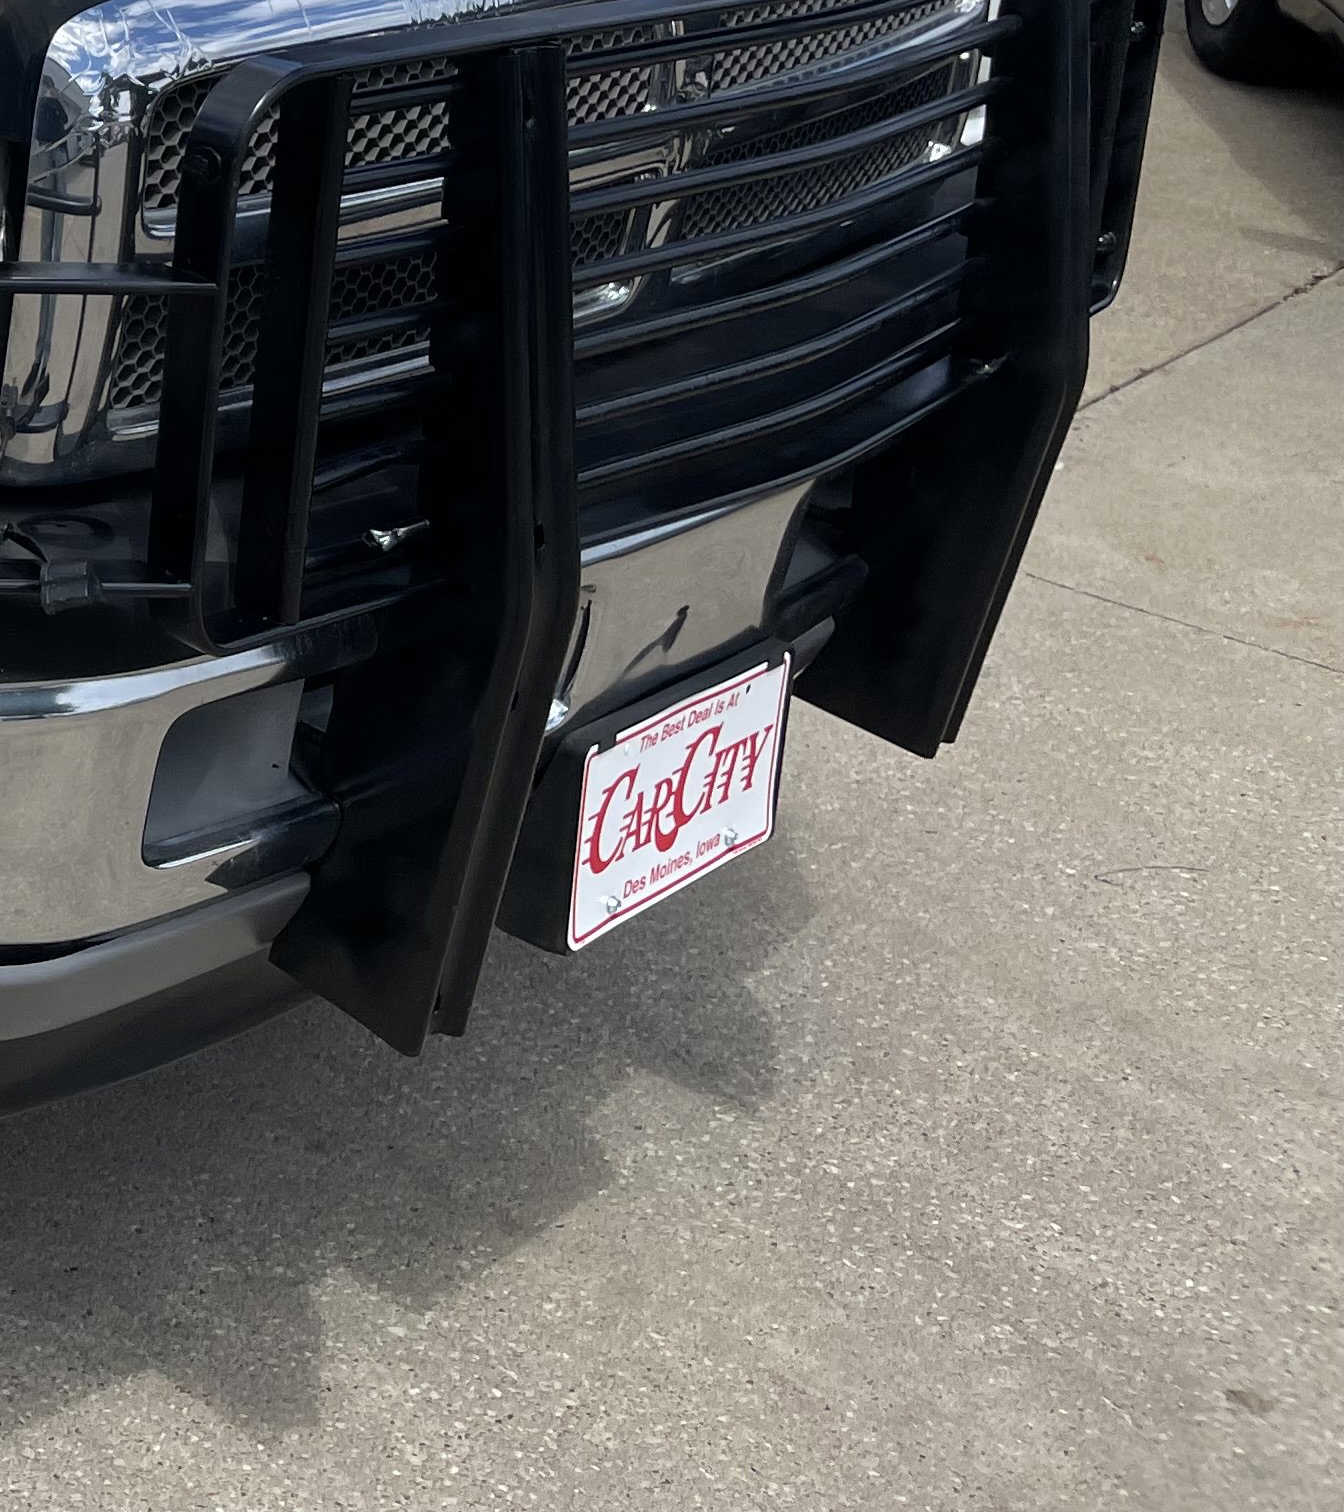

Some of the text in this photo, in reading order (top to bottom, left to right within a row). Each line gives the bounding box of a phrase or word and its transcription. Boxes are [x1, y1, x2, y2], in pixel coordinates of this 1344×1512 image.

[640, 693, 740, 754] The Best Deal Is At
[623, 874, 647, 899] Des
[649, 852, 693, 884] Moines,
[696, 832, 721, 858] Iowa
